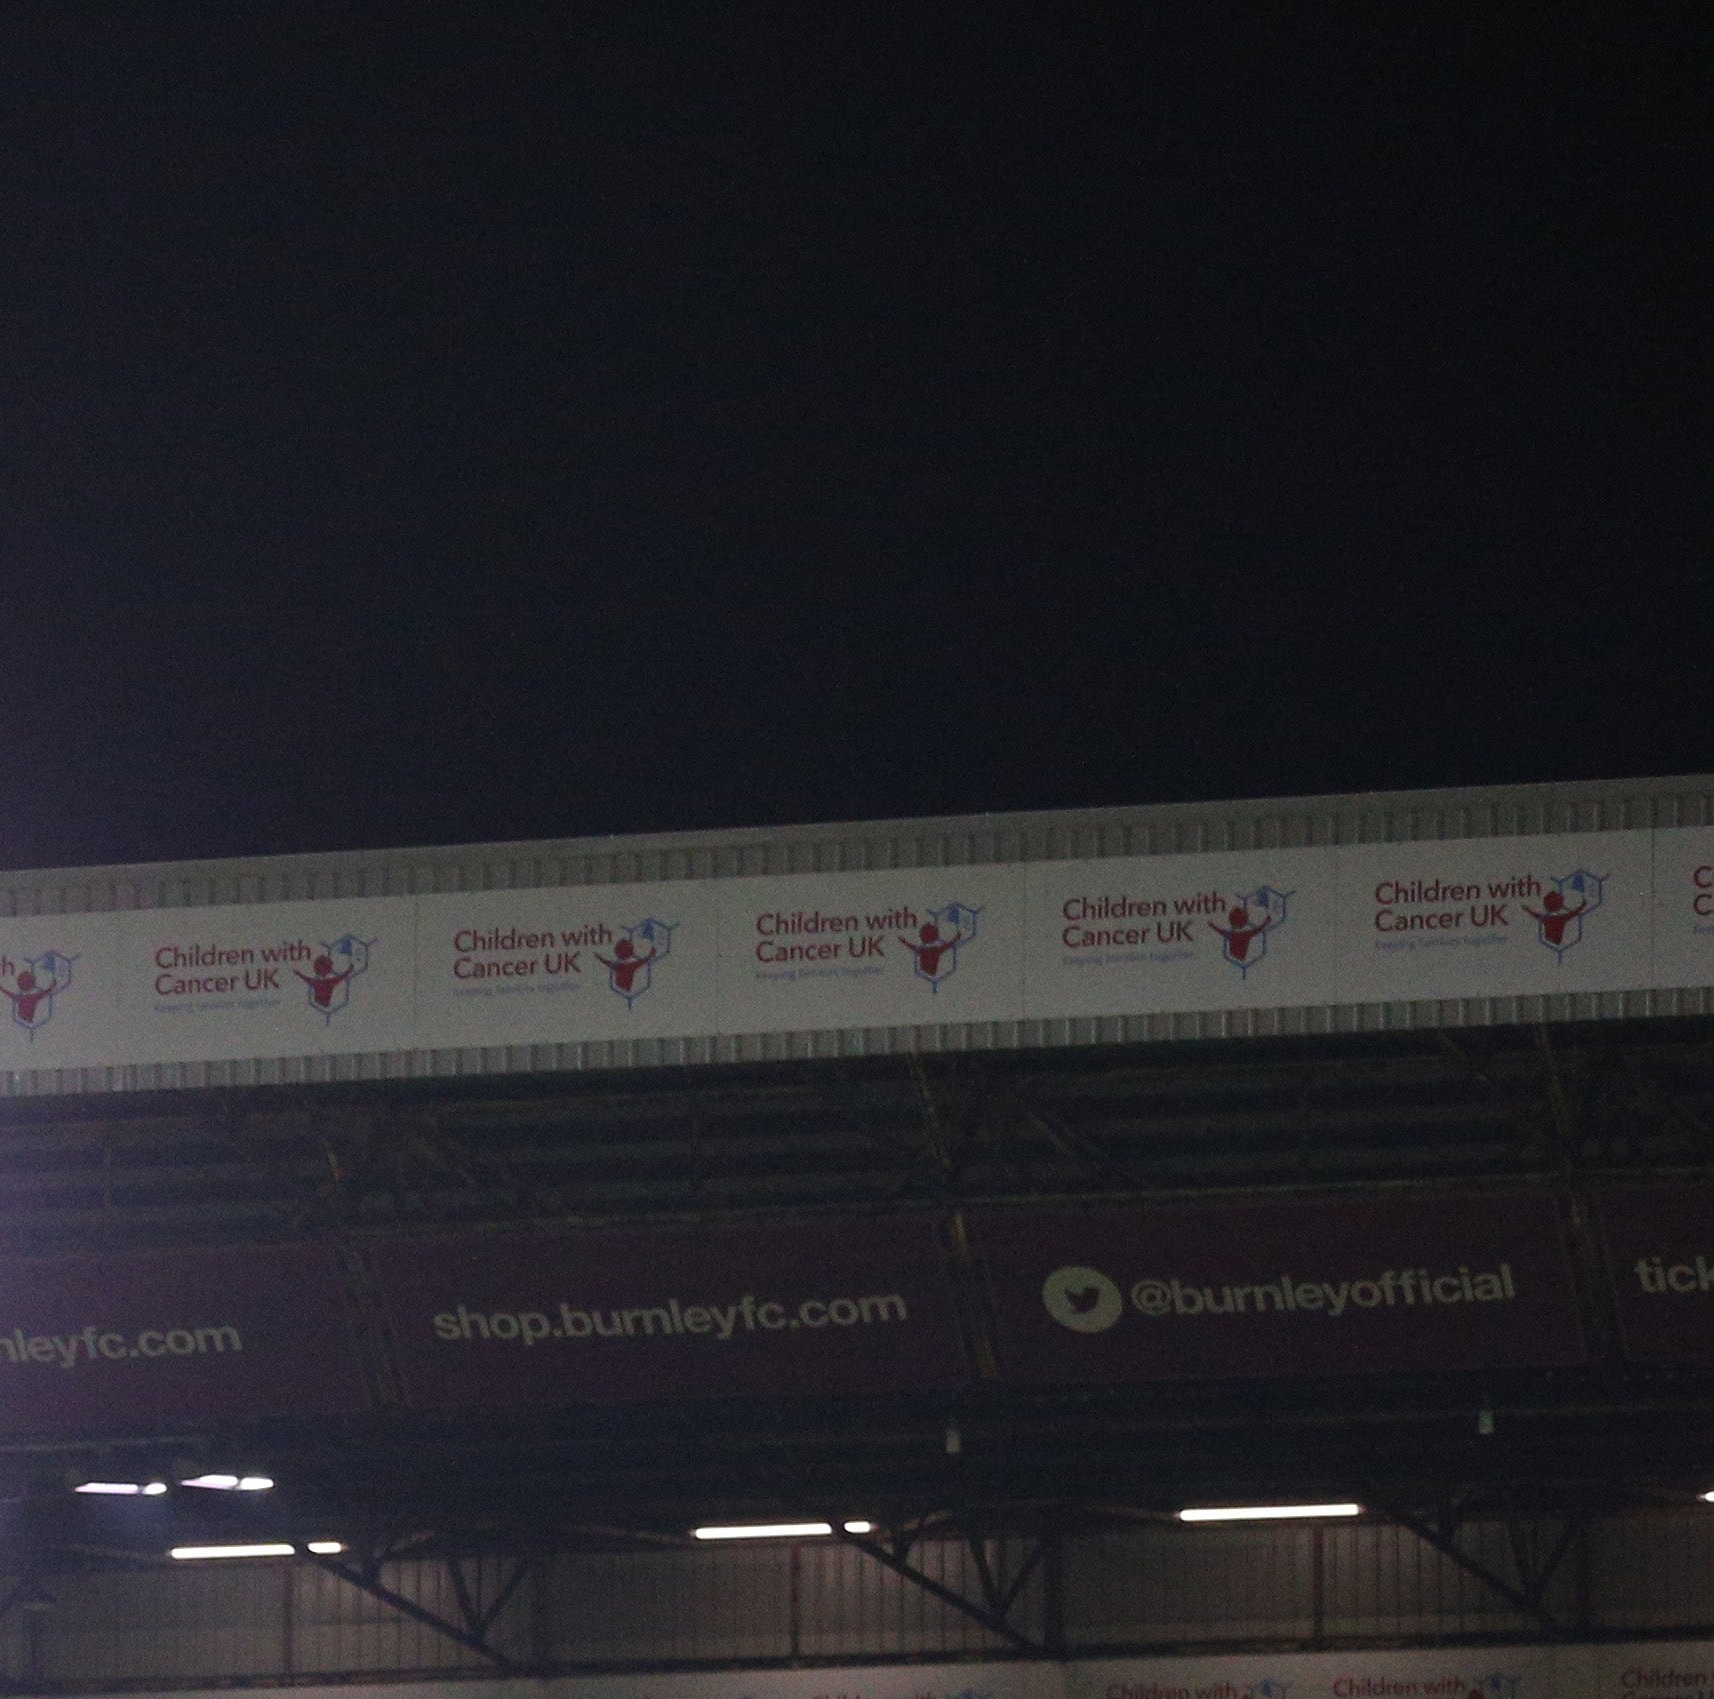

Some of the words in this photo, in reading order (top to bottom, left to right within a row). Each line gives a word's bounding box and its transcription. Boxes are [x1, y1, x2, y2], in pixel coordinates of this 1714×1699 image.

[1375, 879, 1482, 905] Children
[1487, 874, 1543, 898] with
[1062, 895, 1168, 921] Children
[1173, 890, 1228, 915] with
[1374, 909, 1465, 932] Cancer
[1470, 903, 1509, 927] UK
[756, 910, 860, 936] Children
[865, 906, 919, 930] with
[1062, 925, 1152, 947] Cancer
[1156, 919, 1194, 943] UK
[454, 927, 556, 953] Children
[561, 922, 614, 946] with
[755, 940, 844, 962] Cancer
[848, 934, 886, 958] UK
[155, 943, 256, 969] Children
[261, 939, 313, 963] with
[453, 956, 540, 979] Cancer
[544, 950, 581, 974] UK
[154, 973, 240, 995] Cancer
[244, 967, 281, 991] UK
[1128, 1264, 1515, 1318] @burnleyofficial
[432, 1293, 909, 1346] shop.burnleyfc.com
